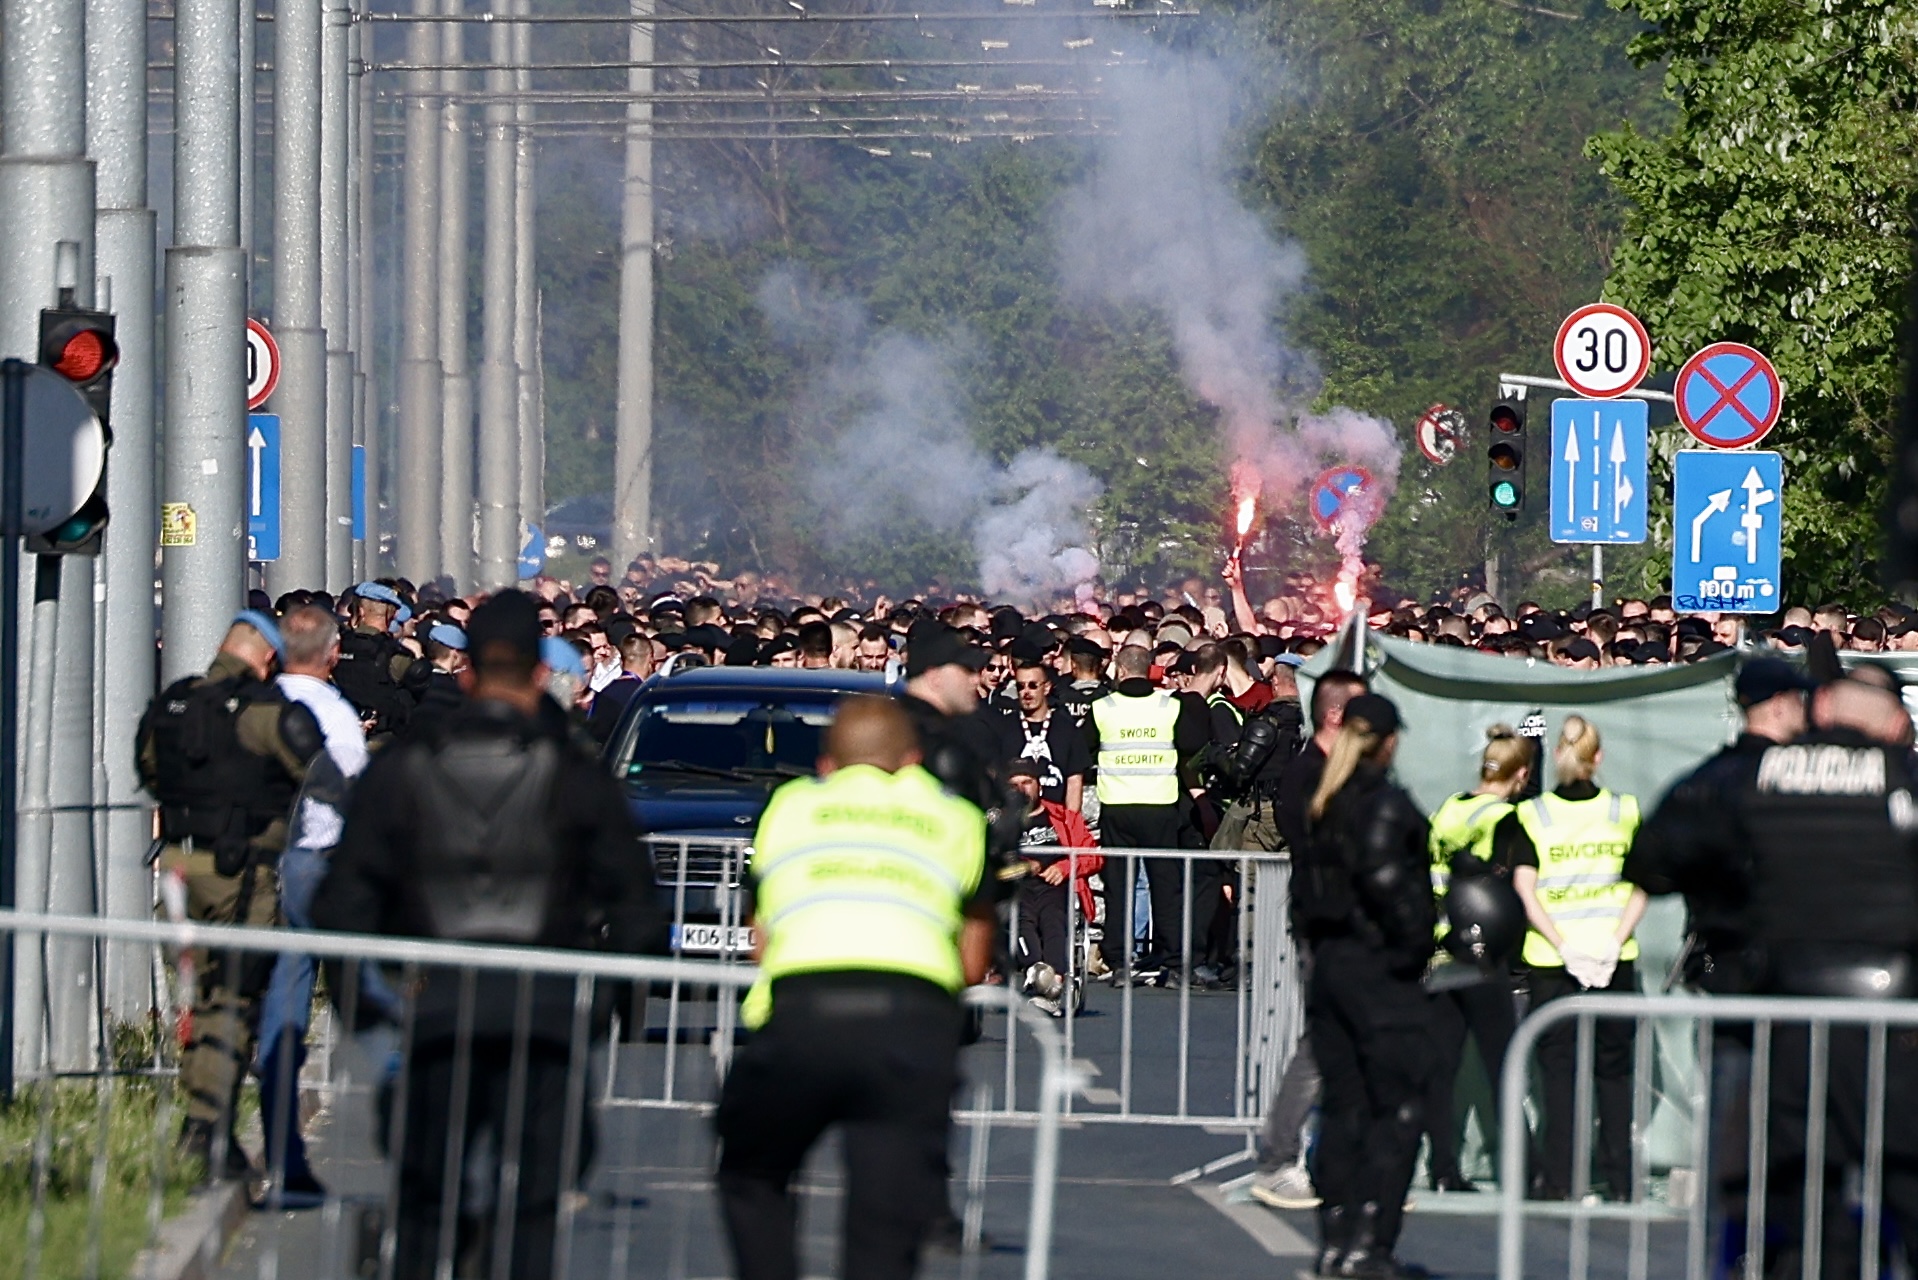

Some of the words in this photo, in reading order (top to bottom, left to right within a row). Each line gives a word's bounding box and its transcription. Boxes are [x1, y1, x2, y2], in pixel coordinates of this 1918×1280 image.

[1576, 327, 1627, 373] 30
[1699, 580, 1735, 599] 100
[1737, 585, 1755, 599] m
[1120, 728, 1156, 739] SWORD
[1115, 754, 1163, 765] SECURITY
